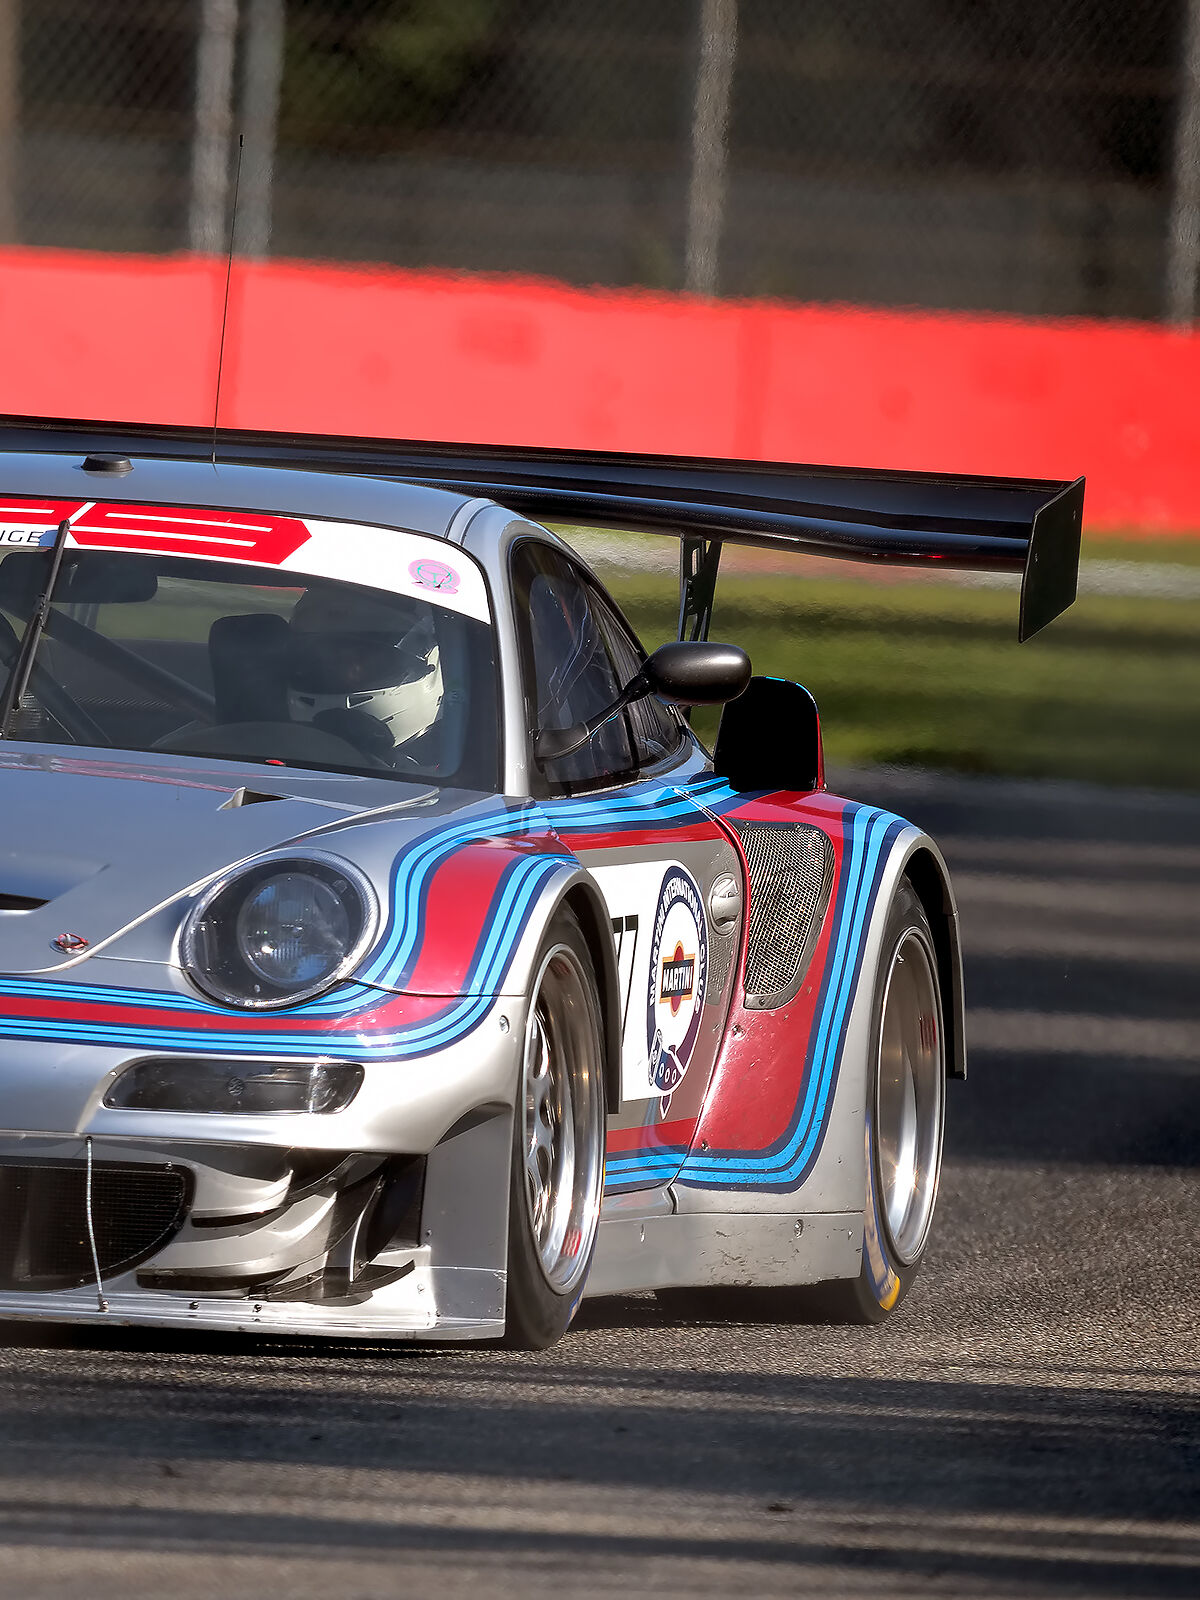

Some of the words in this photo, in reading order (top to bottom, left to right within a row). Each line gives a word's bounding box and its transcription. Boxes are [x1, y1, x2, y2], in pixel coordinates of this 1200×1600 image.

[650, 903, 667, 1007] MARTINI
[662, 876, 703, 941] INTERNATIONAL
[694, 943, 706, 1014] CLUB
[661, 965, 694, 993] MARTINI
